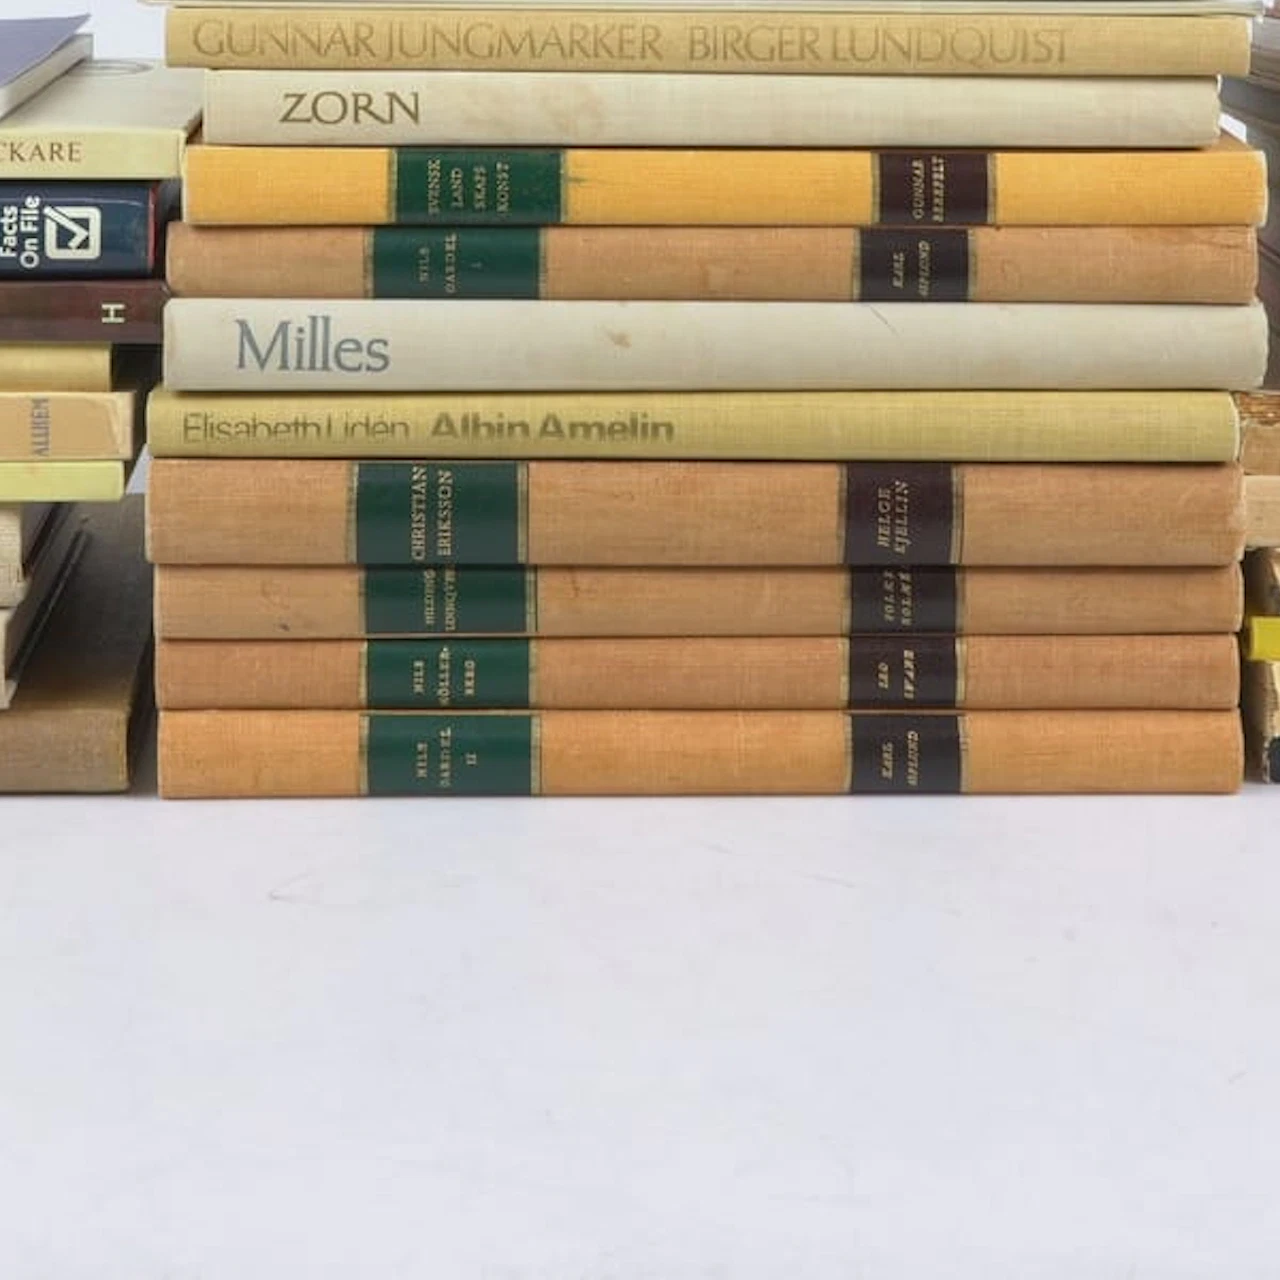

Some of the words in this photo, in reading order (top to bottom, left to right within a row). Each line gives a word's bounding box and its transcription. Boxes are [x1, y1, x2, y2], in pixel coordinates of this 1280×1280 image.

[192, 21, 375, 59] GUNNAR
[385, 22, 663, 62] JUNGMARKER
[688, 24, 820, 63] BIRGER
[832, 26, 1068, 69] LUNDQUIST
[279, 90, 420, 125] ZORN
[19, 195, 41, 235] File
[19, 236, 40, 269] On
[101, 303, 127, 324] H
[235, 315, 391, 372] Milles
[183, 412, 321, 444] Elisabeth
[430, 411, 531, 441] Albin
[537, 411, 676, 442] Amelin
[411, 463, 428, 561] CHRISTIAN
[436, 469, 454, 557] ERIKSSON
